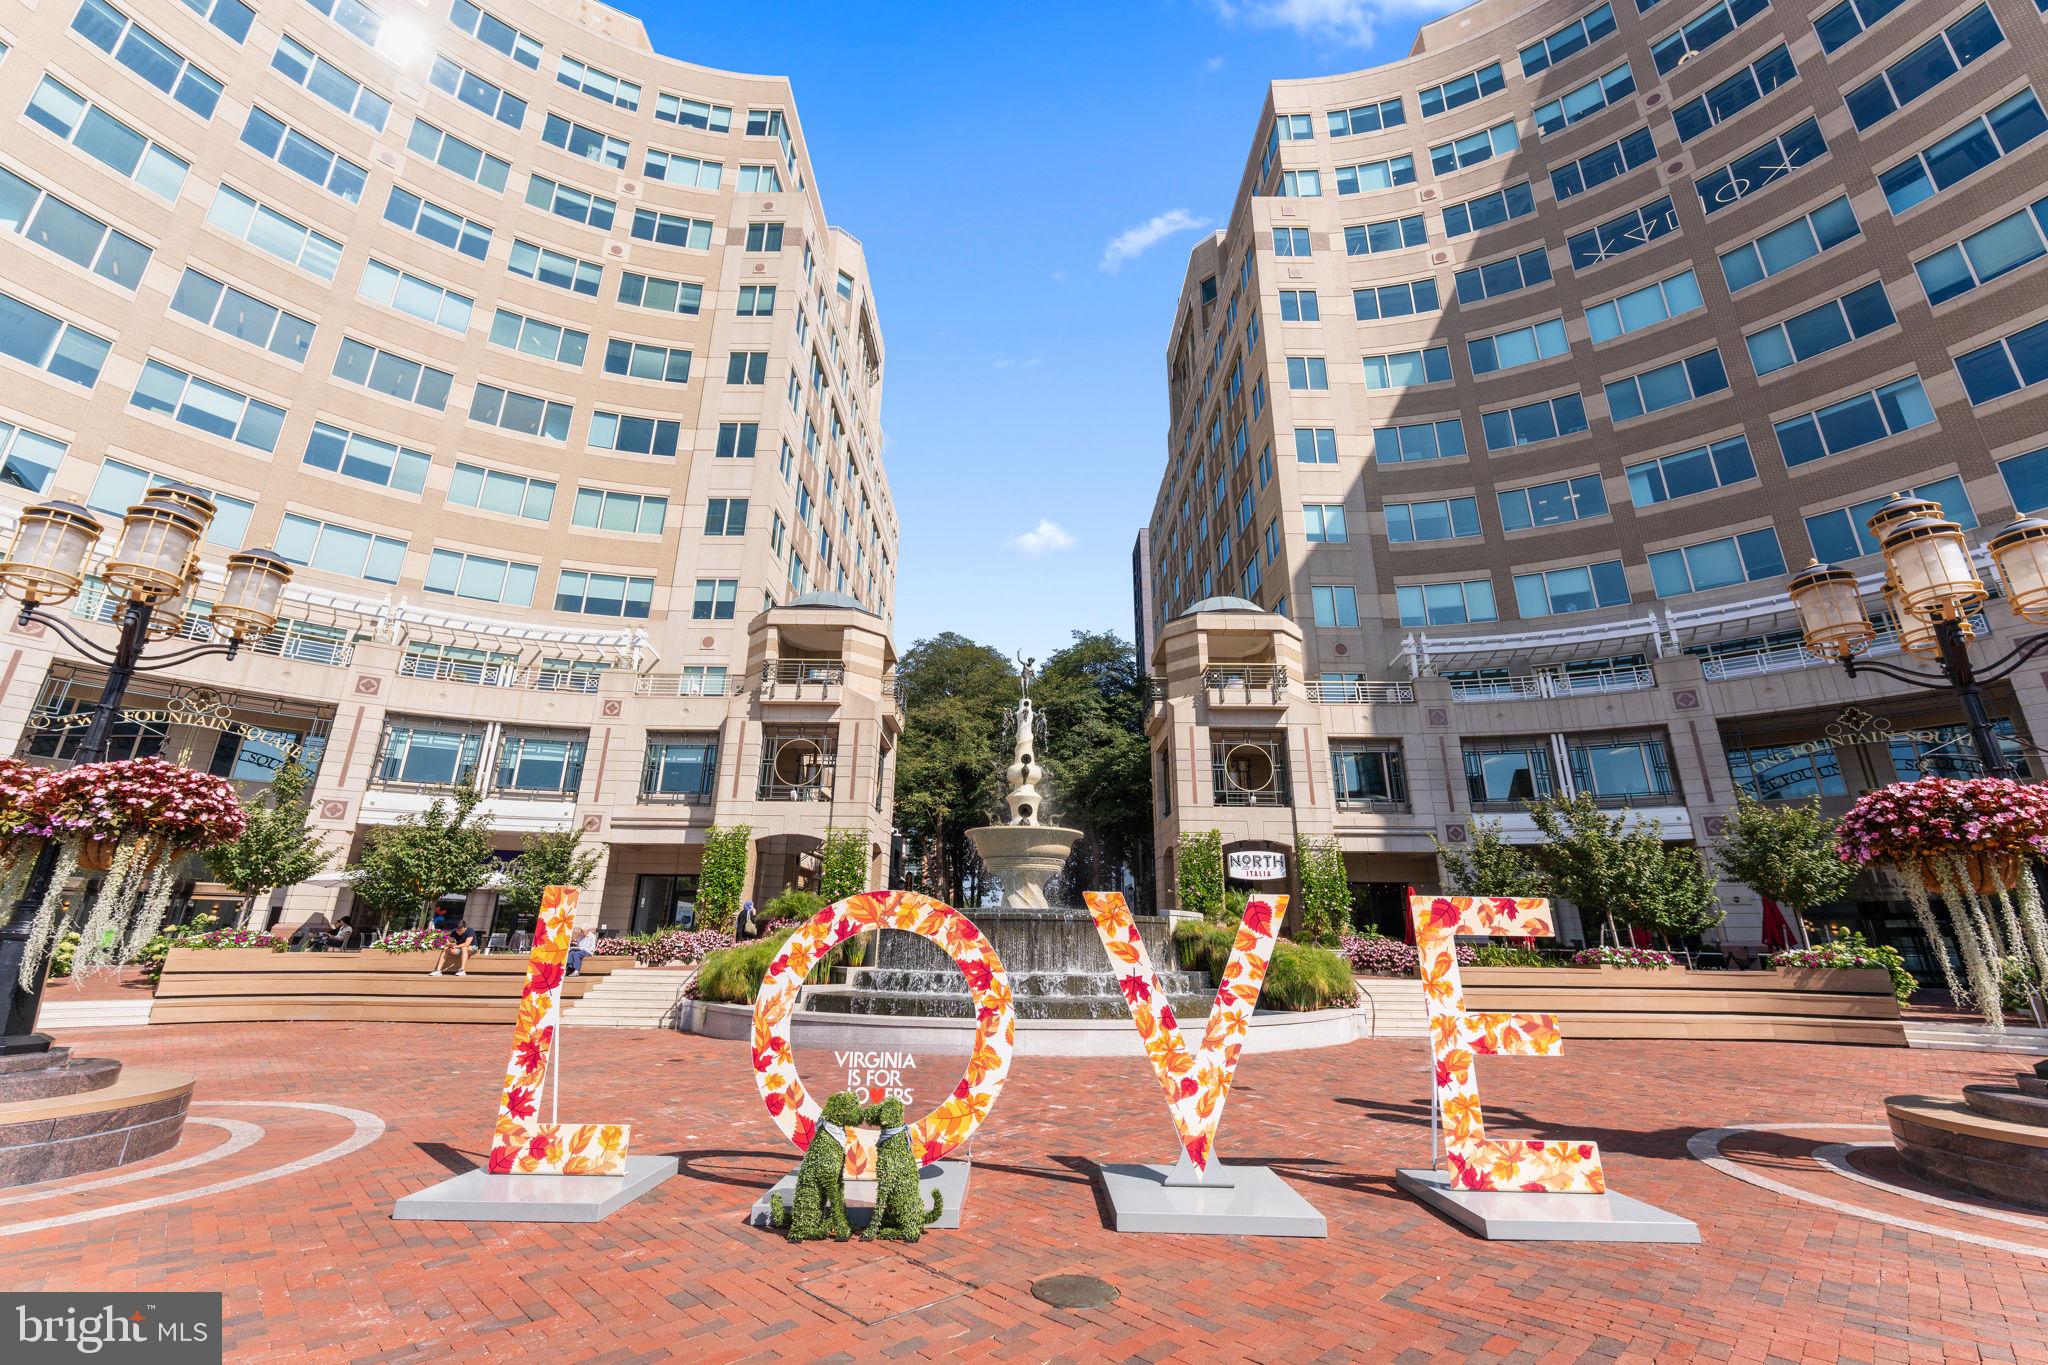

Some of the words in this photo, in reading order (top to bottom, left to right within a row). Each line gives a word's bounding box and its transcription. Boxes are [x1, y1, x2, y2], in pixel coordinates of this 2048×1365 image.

[124, 711, 232, 732] FOUNTAIN
[237, 723, 305, 759] SQUARE
[1752, 752, 1789, 773] ONE
[1791, 730, 1895, 758] FOUNTAIN
[1904, 731, 1975, 748] SQUA
[1230, 854, 1285, 870] NORTH
[834, 1051, 917, 1069] VIRGINIA
[847, 1069, 862, 1087] IS
[866, 1069, 904, 1087] FOR
